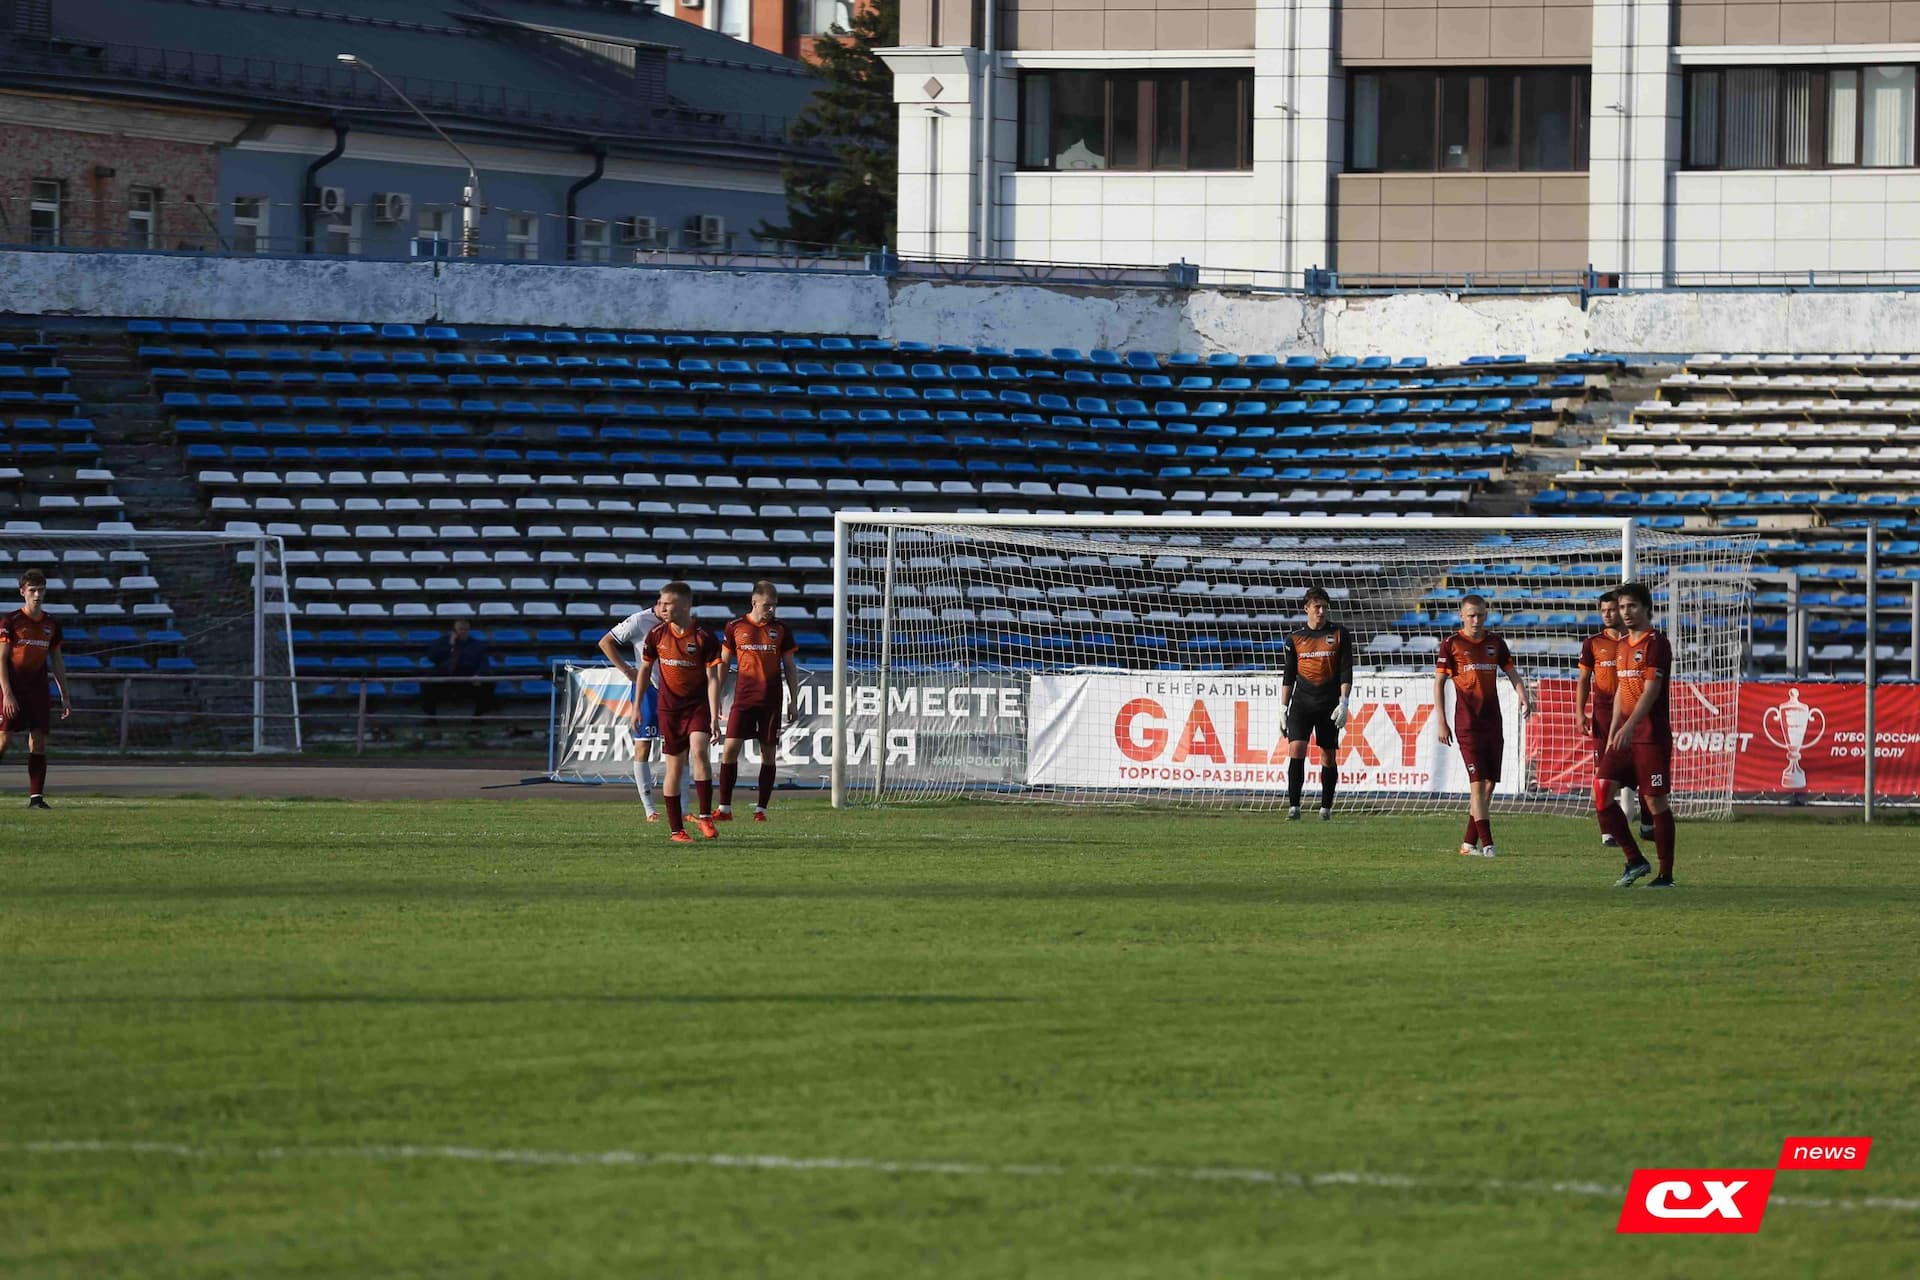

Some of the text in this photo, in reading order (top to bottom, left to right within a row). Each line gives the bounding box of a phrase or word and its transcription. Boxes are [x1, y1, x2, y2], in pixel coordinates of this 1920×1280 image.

[1145, 682, 1279, 697] ГЕНЕРАЛЬНЫ
[644, 725, 657, 737] 30
[1833, 732, 1865, 742] КУБО
[1830, 746, 1905, 758] ПО ФУБОЛУ
[1376, 772, 1430, 787] ЦЕНТР
[1650, 774, 1663, 787] 23
